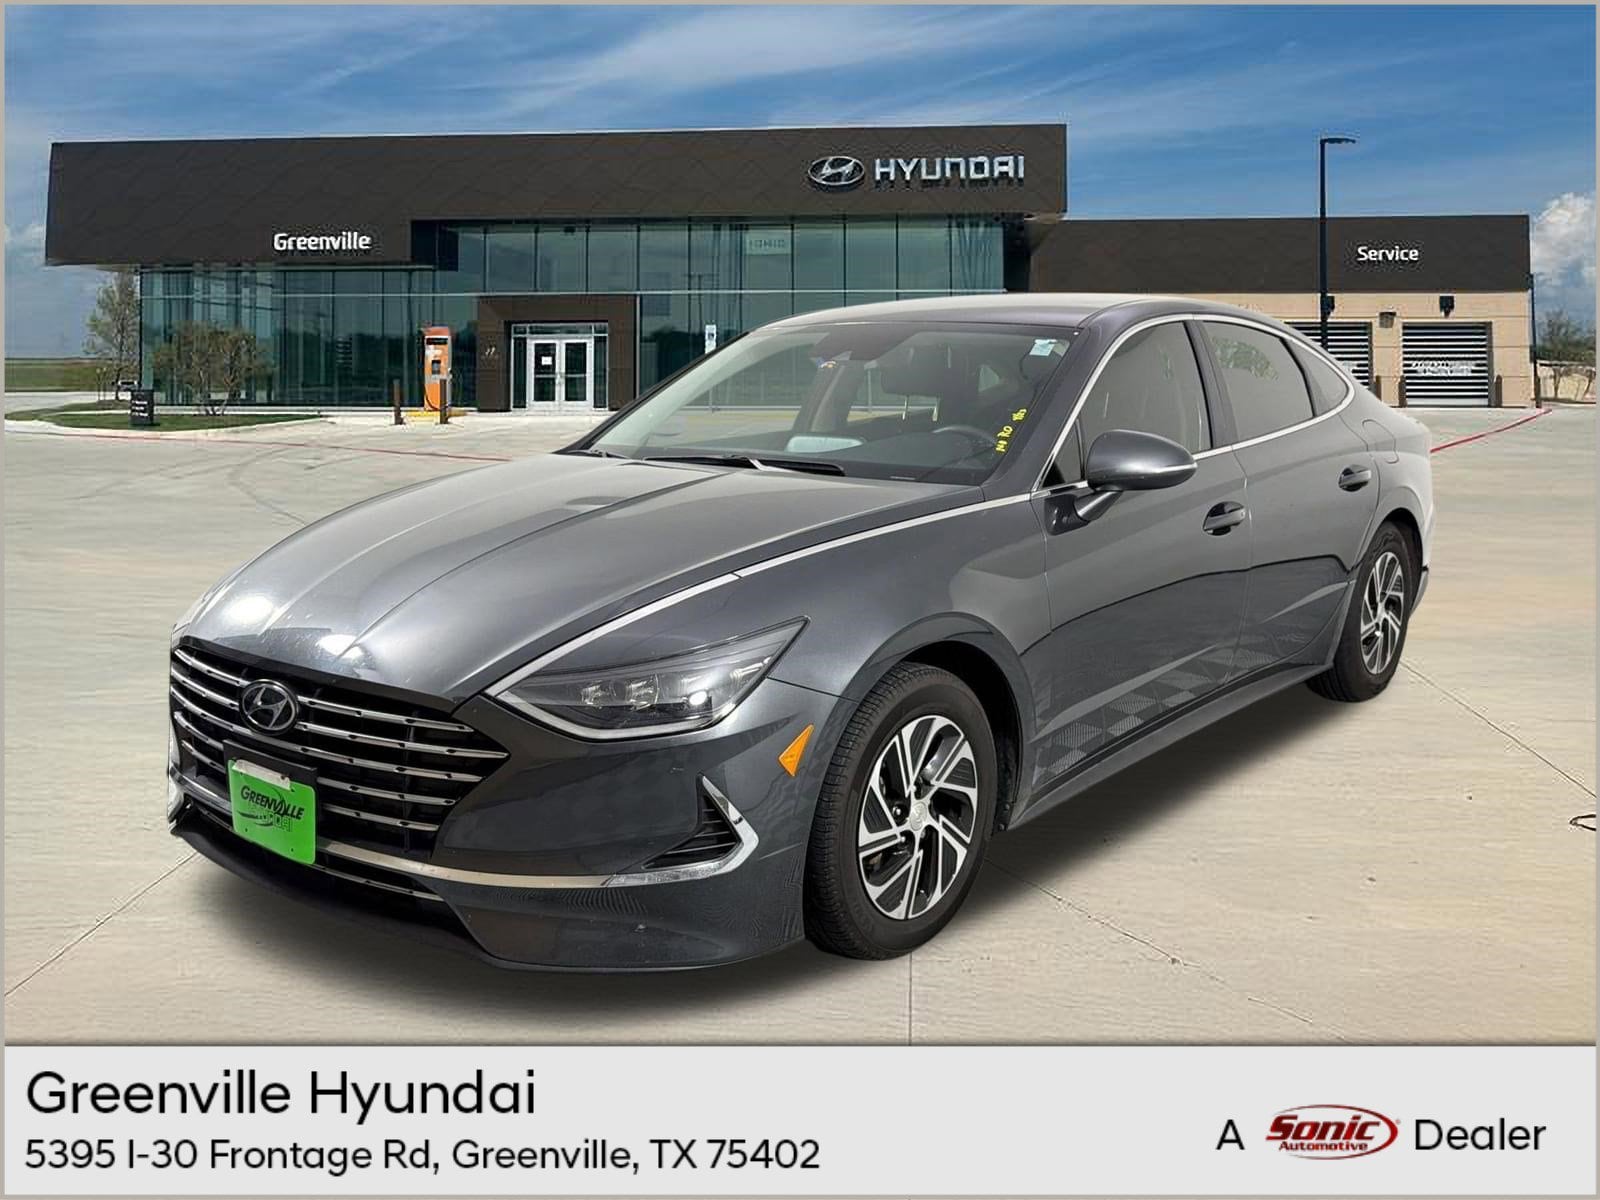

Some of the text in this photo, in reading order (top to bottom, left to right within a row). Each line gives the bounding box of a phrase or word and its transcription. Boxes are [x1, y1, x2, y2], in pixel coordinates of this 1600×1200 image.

[874, 155, 1025, 181] HYUNDAI
[273, 231, 372, 251] Greenville
[1357, 245, 1419, 261] Service
[240, 785, 305, 821] GREENVILLE
